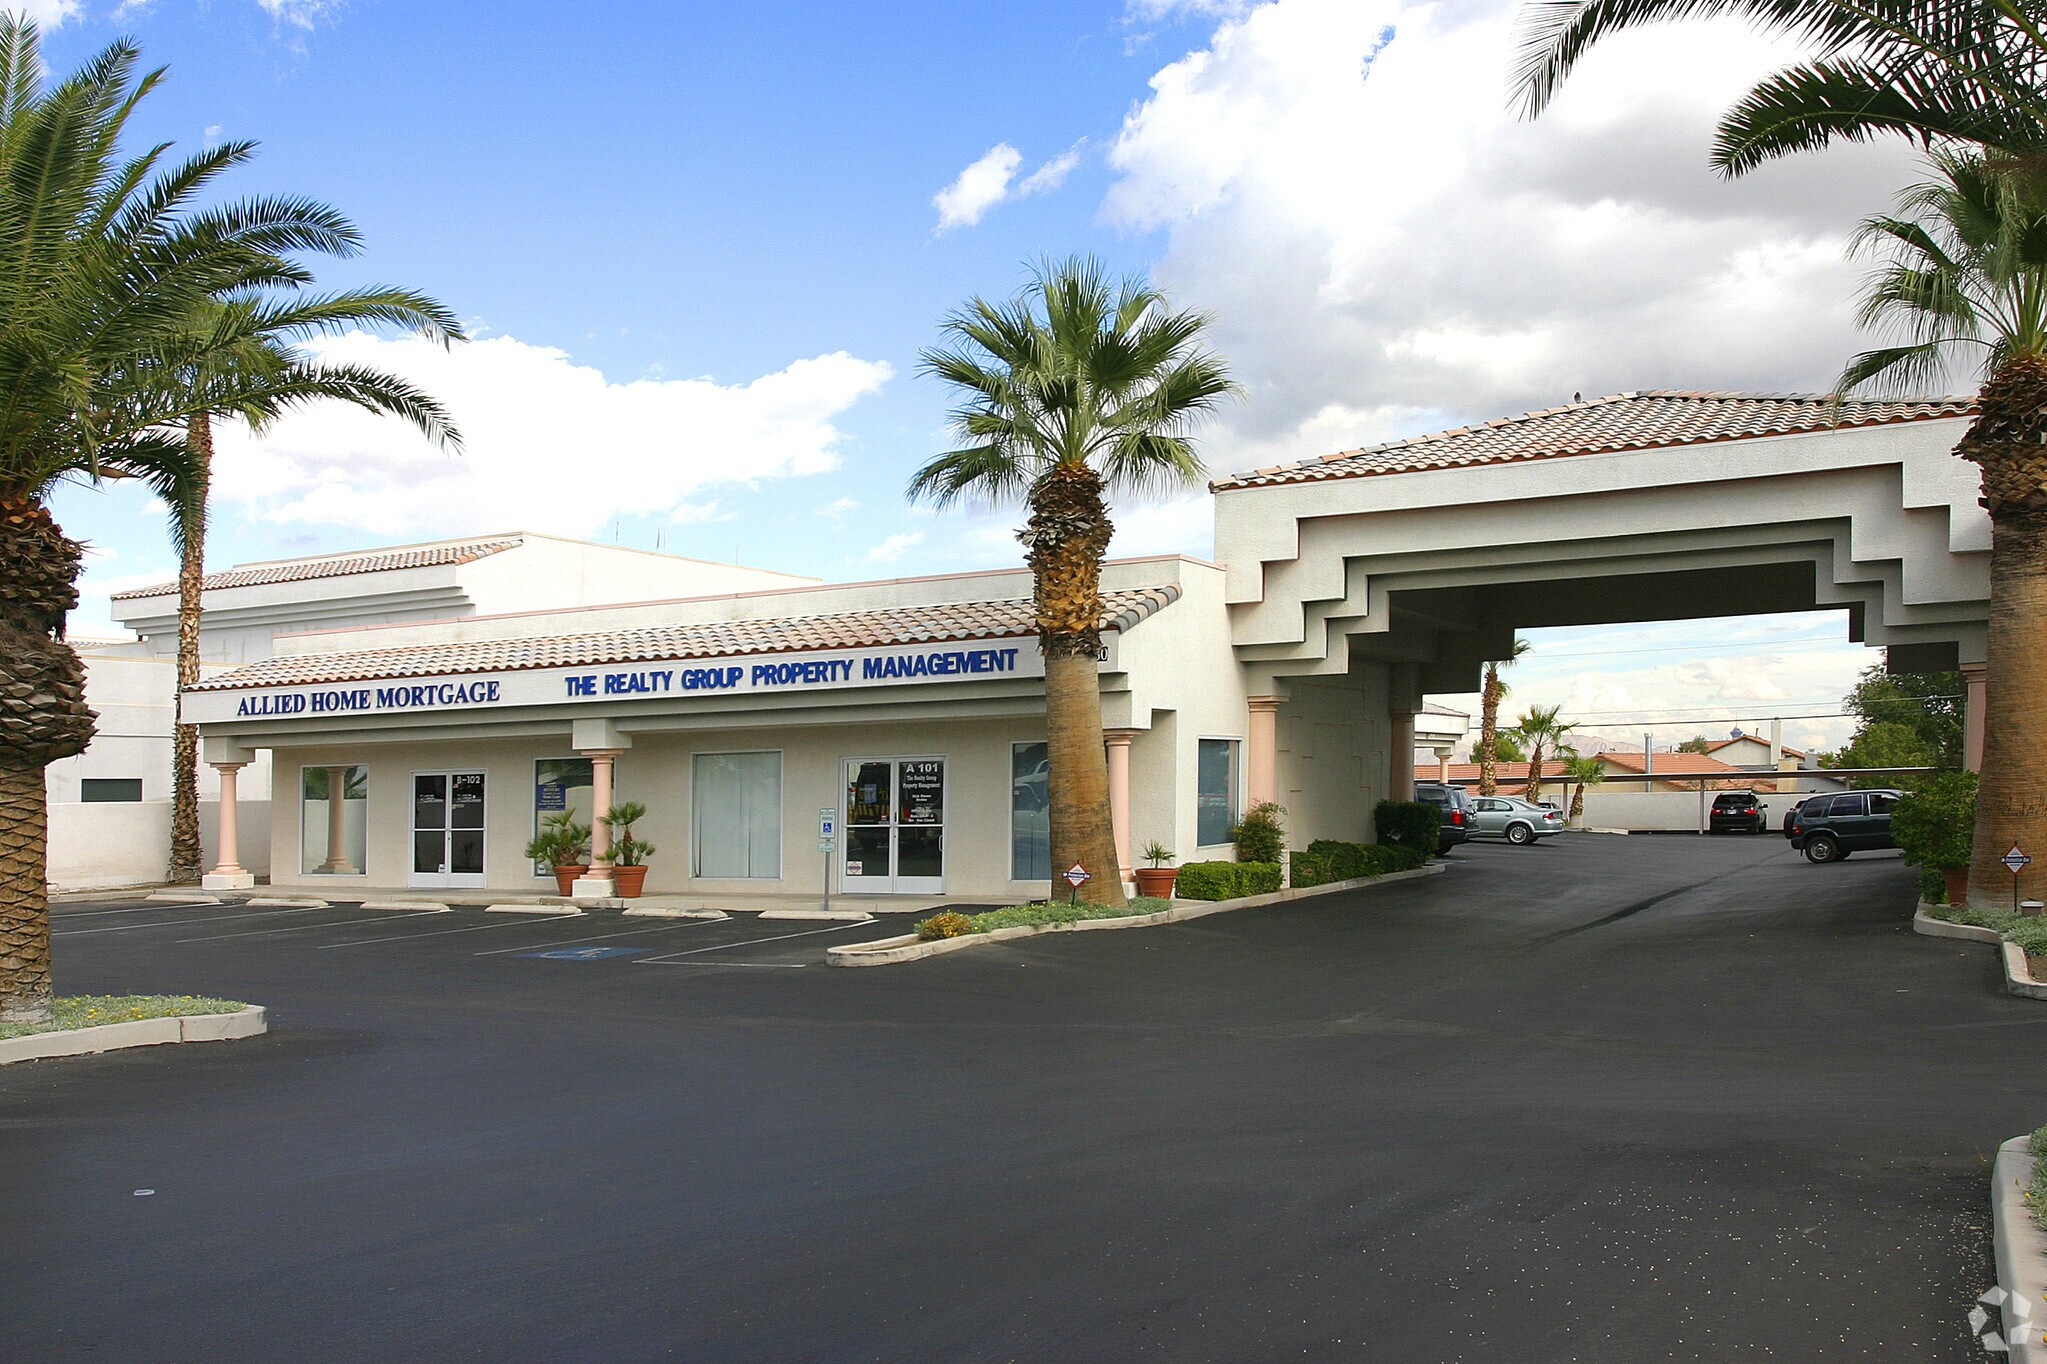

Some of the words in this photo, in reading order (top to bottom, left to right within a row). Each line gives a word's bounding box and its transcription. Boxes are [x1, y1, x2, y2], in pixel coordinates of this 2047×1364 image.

[565, 675, 598, 697] THE
[604, 670, 673, 694] REALTY
[681, 666, 744, 690] GROUP
[752, 659, 854, 687] PROPERTY
[863, 648, 1019, 680] MANAGEMENT
[237, 693, 306, 716] ALLIED
[311, 690, 371, 712] HOME
[376, 681, 500, 708] MORTGAGE
[906, 764, 915, 773] A
[918, 763, 938, 773] 101
[456, 775, 481, 784] B-102
